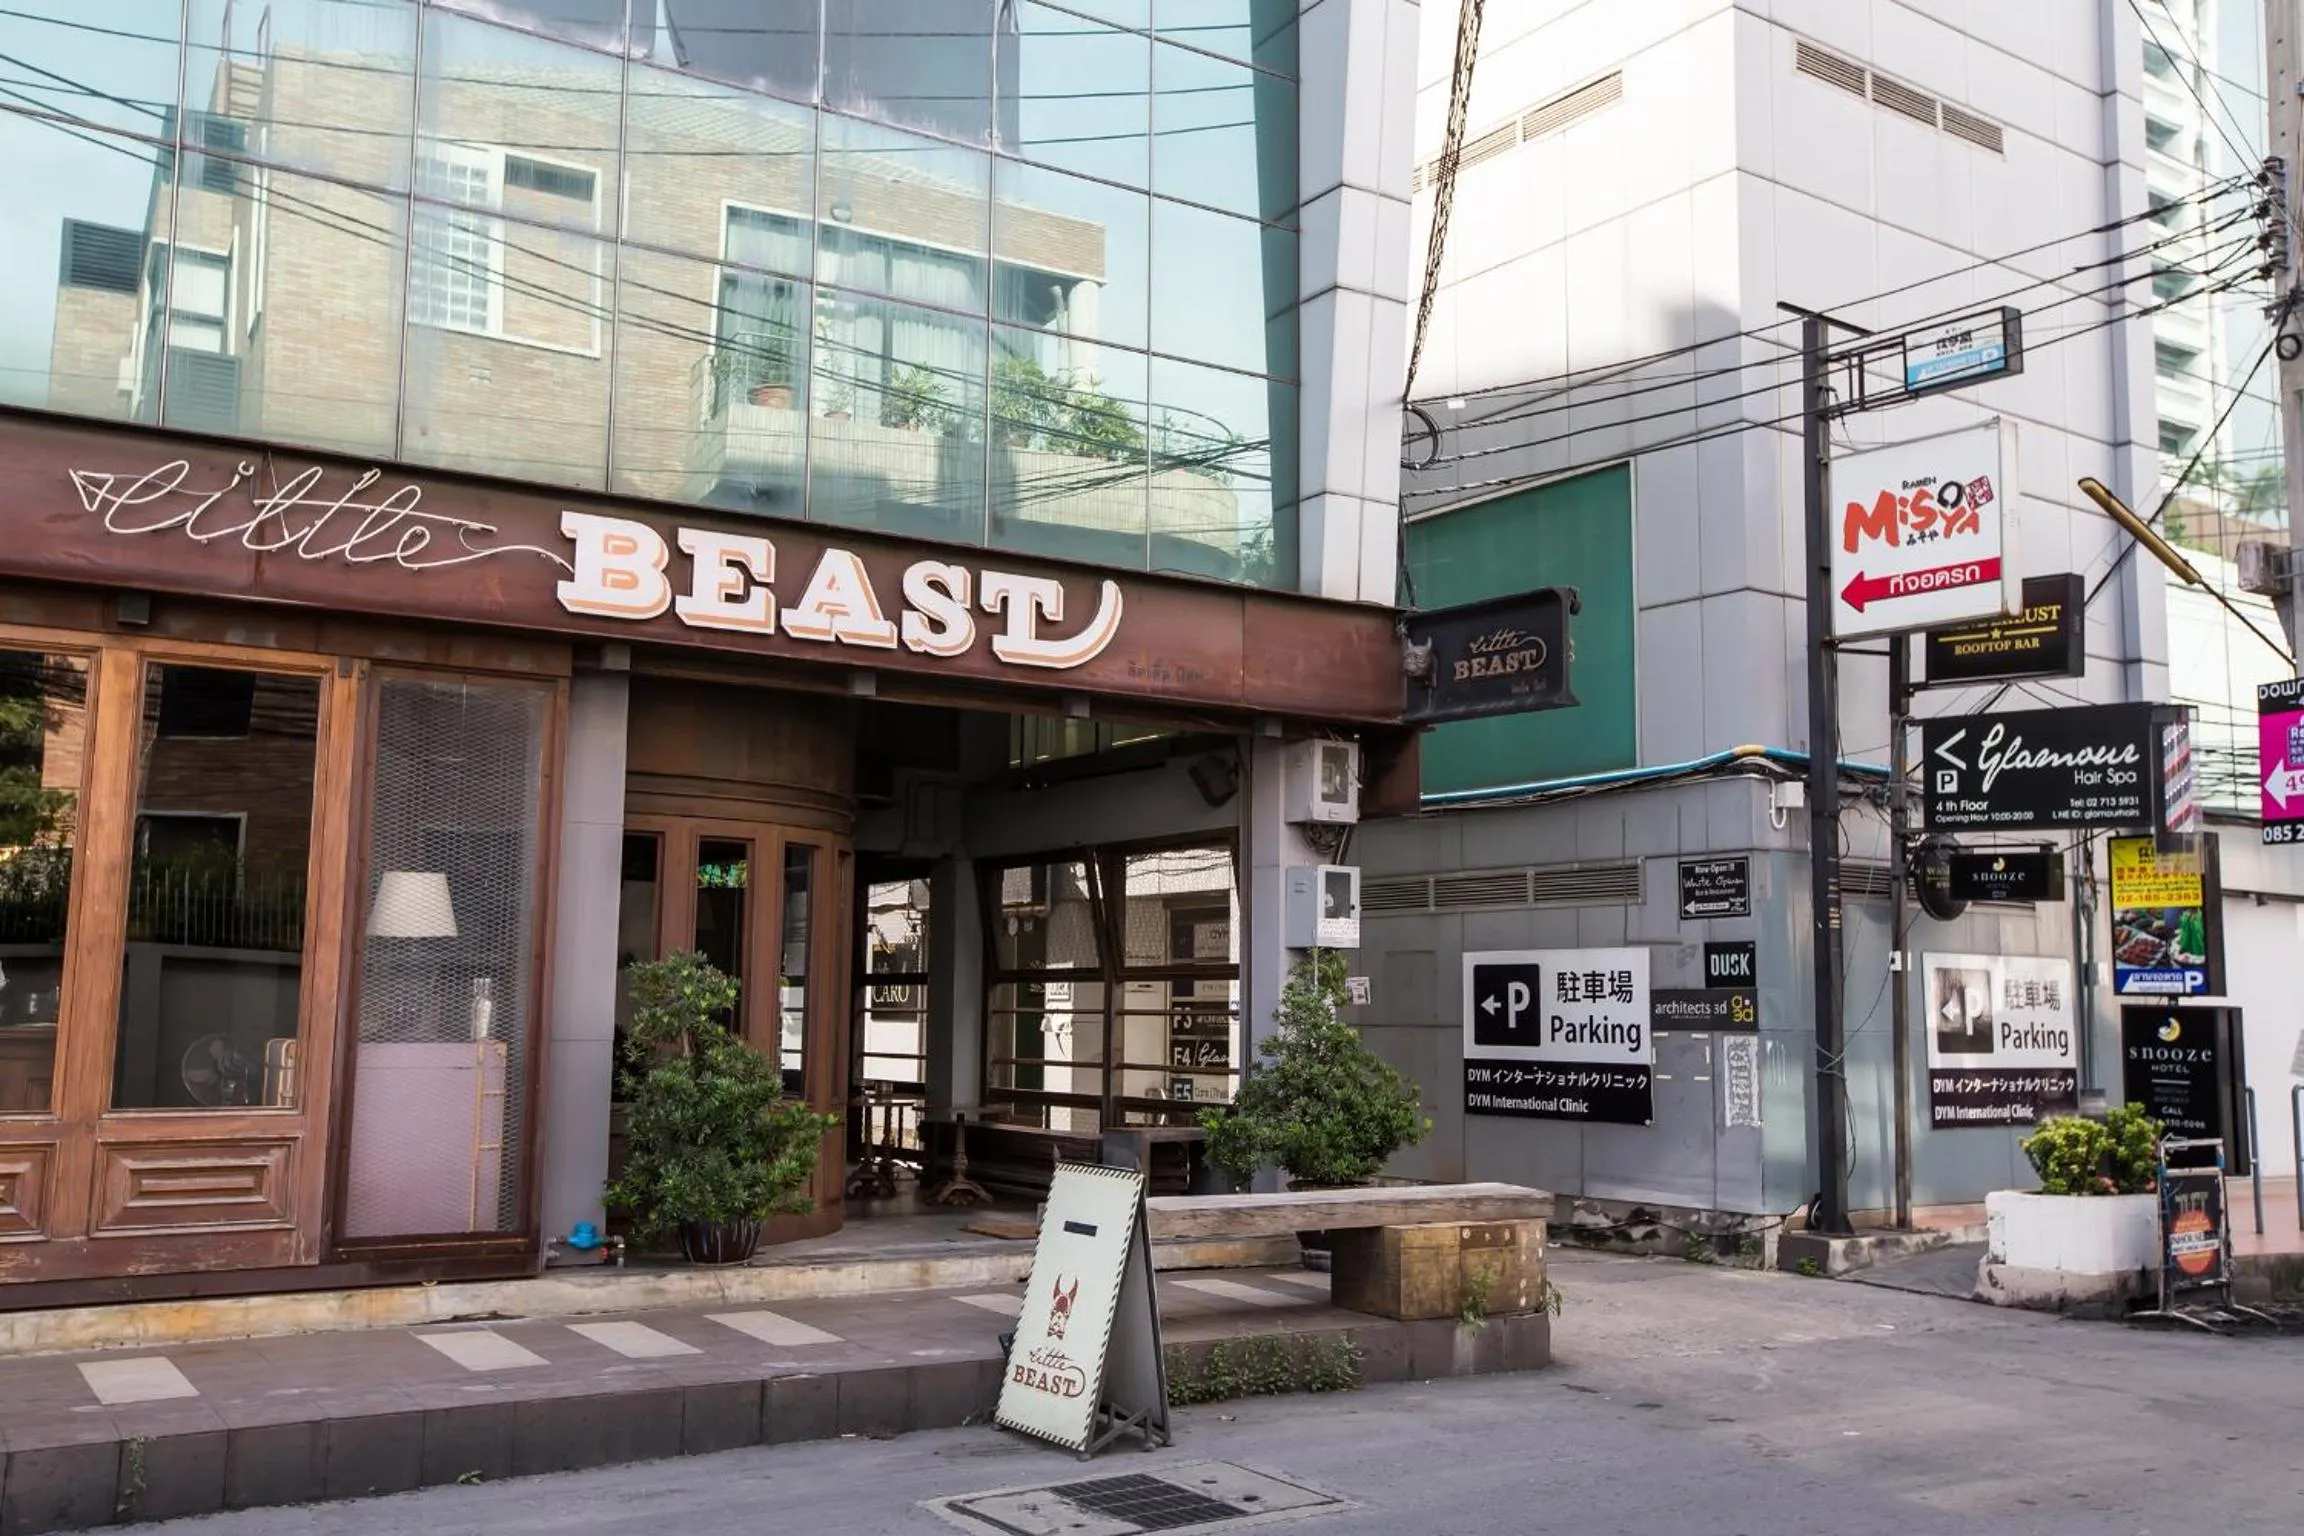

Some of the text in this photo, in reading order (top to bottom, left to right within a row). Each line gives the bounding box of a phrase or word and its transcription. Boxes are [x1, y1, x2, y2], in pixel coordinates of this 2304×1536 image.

[1902, 476, 1937, 490] RAMEN
[557, 510, 1123, 669] BEAST
[1954, 636, 2040, 656] ROOFTOP BAR
[1453, 644, 1547, 681] BEAST
[1978, 722, 2140, 793] Glamour
[2074, 767, 2137, 786] Hair Spa
[1936, 799, 1989, 812] 4 th Floor
[2086, 798, 2098, 807] 02
[2100, 796, 2117, 807] 713
[1935, 814, 1969, 824] Opening
[1970, 812, 1989, 821] Hour
[2263, 826, 2292, 842] 085
[1711, 864, 1727, 874] Open
[1971, 871, 2026, 882] snooze
[1710, 953, 1750, 976] DUSK
[1557, 970, 1633, 1004] 駐車場
[2184, 971, 2204, 994] P
[2004, 978, 2061, 1011] 駐車場
[1508, 981, 1531, 1029] P
[1655, 1001, 1711, 1015] architects
[1550, 1015, 1642, 1052] Parking
[2001, 1022, 2069, 1056] Parking
[2129, 1046, 2213, 1062] snooze
[2151, 1064, 2190, 1073] HOTEL
[1468, 1069, 1648, 1090] DYM インターナショナルクリニック
[1933, 1077, 2074, 1094] DYM インターナショナルクリニック
[1468, 1093, 1589, 1113] DYM International Clinic
[1934, 1103, 2034, 1120] DYM International Clinic
[2162, 1106, 2182, 1115] CALL
[1012, 1364, 1086, 1398] BEAST
